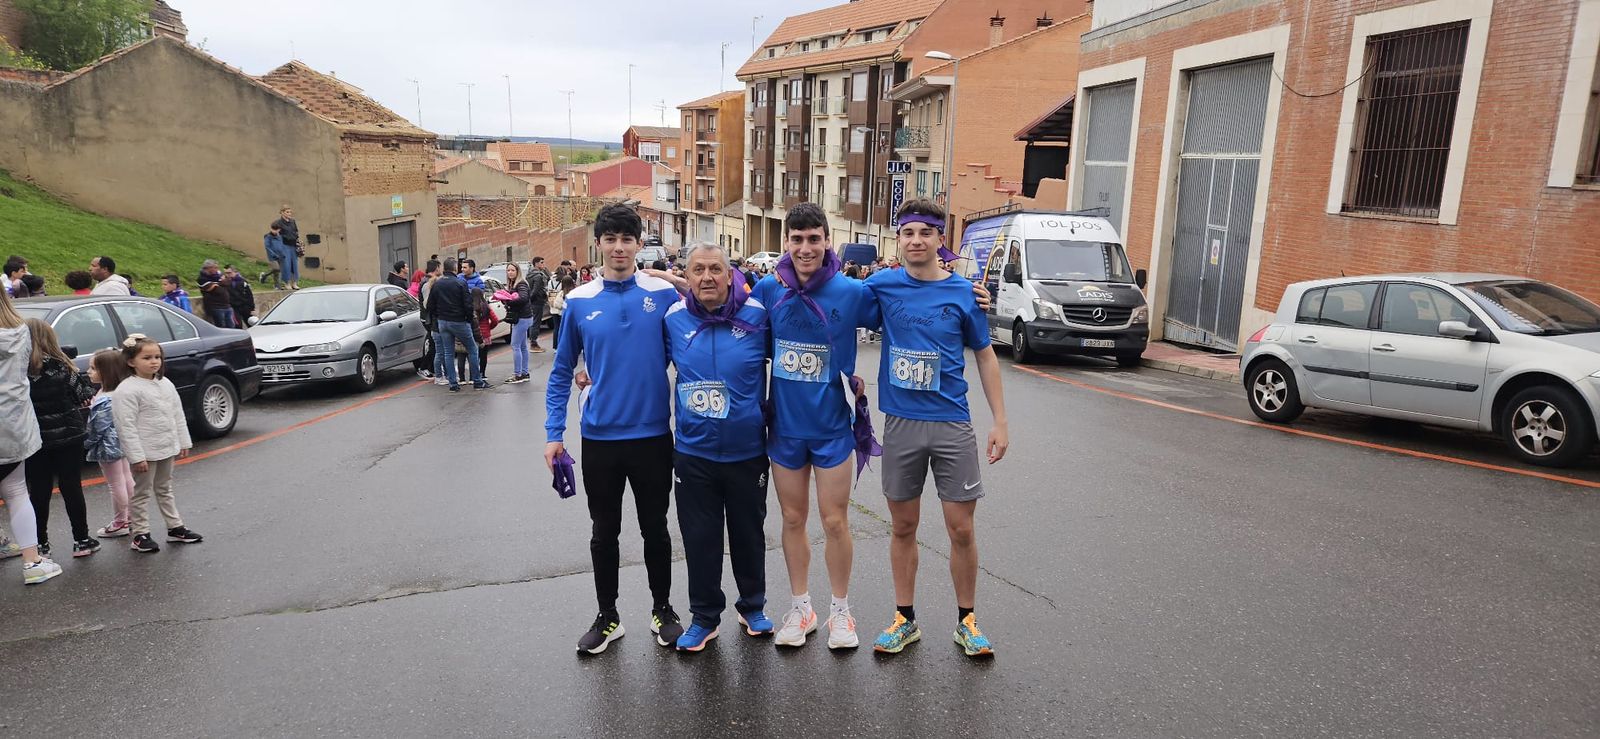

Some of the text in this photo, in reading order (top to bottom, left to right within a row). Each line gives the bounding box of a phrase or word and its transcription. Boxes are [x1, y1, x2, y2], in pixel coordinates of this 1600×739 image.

[889, 162, 911, 173] JLC
[784, 350, 818, 374] 99
[895, 357, 925, 382] 81
[692, 389, 721, 412] 96
